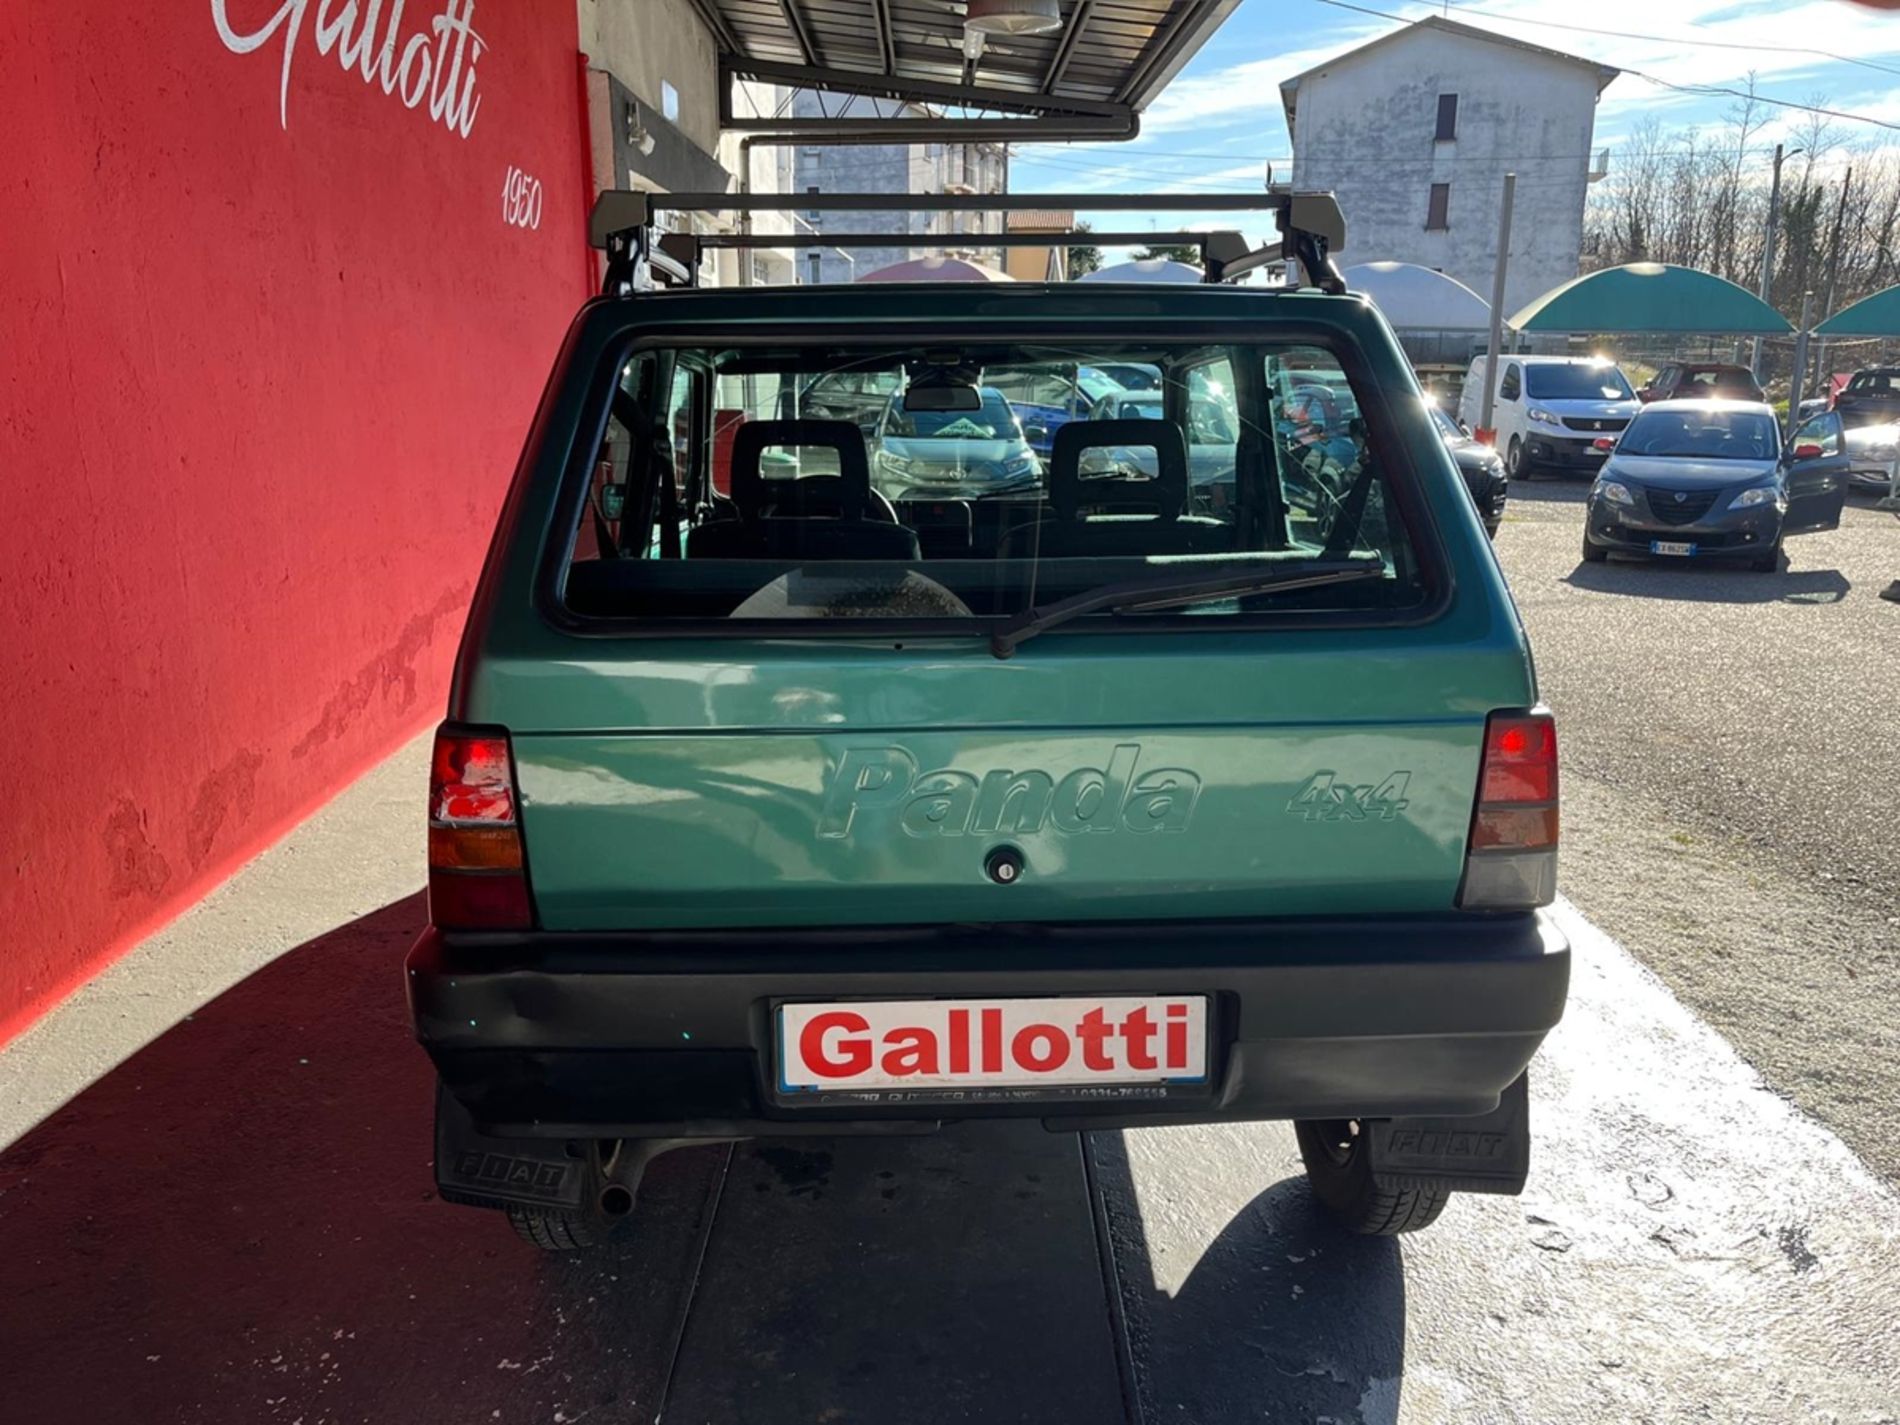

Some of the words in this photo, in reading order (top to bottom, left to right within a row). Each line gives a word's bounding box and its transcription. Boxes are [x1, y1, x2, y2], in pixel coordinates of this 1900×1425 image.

[501, 164, 542, 230] 1950
[816, 742, 1202, 839] Panda
[1287, 769, 1412, 822] 4x4
[799, 1003, 1188, 1079] Gallotti
[460, 1156, 561, 1185] FIAT
[1398, 1134, 1502, 1156] FIAT
